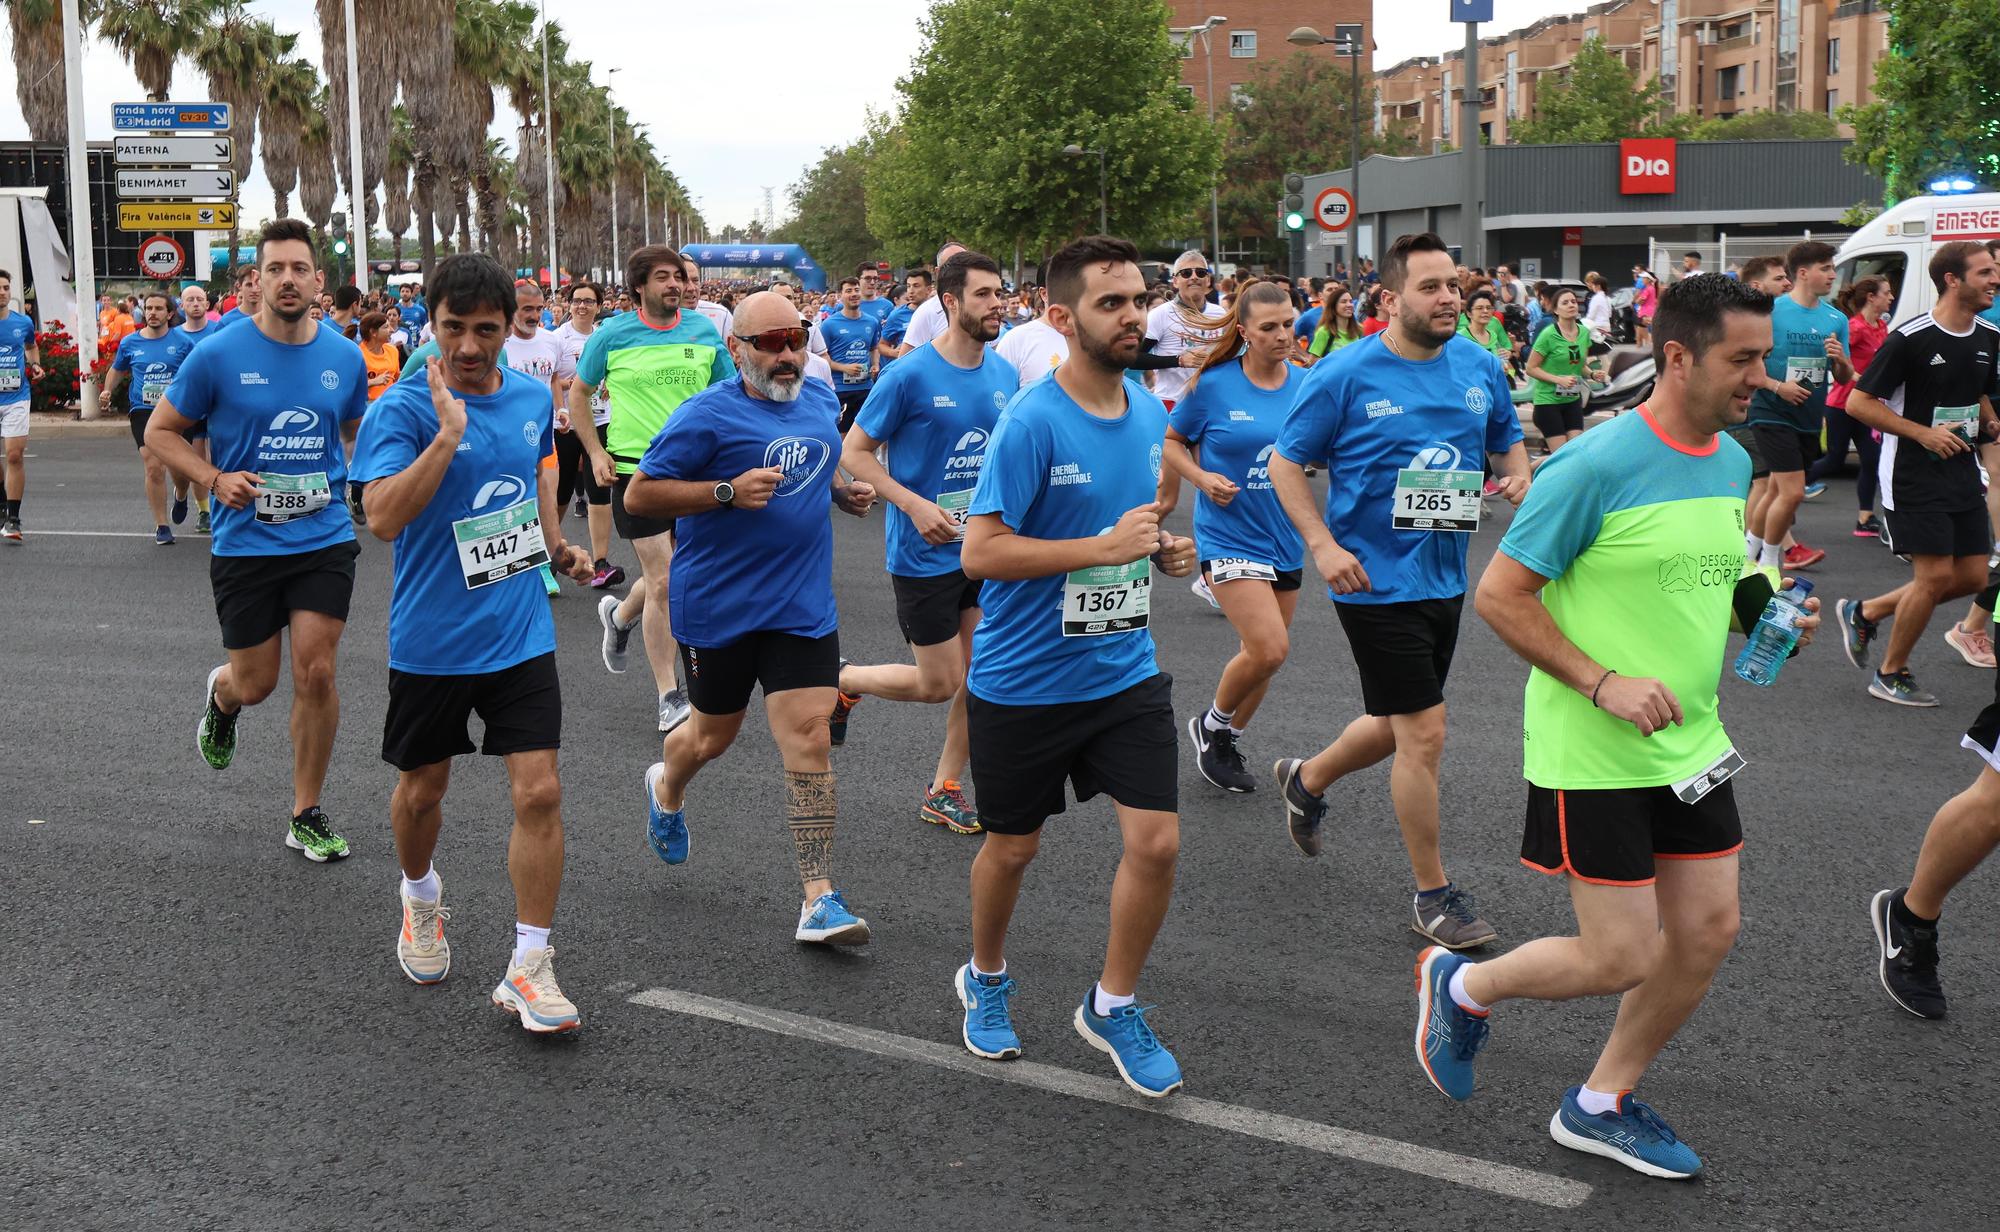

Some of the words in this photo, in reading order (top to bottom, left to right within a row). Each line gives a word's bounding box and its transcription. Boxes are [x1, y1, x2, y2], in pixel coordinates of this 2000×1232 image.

[115, 106, 145, 115] ronda
[151, 106, 175, 115] nord
[135, 118, 171, 126] Madrid
[117, 146, 169, 154] PATERNA
[119, 178, 187, 188] BENIMÀMET
[121, 212, 140, 221] Fira
[147, 212, 191, 221] València
[655, 369, 697, 377] DESGUACE
[656, 376, 697, 385] CORTES
[258, 436, 325, 449] POWER
[780, 441, 808, 473] life
[944, 455, 985, 470] POWE
[1050, 462, 1080, 476] ENERGÍA
[1050, 472, 1092, 486] INAGOTABLE
[263, 493, 307, 509] 1388
[1404, 493, 1452, 511] 1265
[470, 534, 518, 564] 1447
[1700, 554, 1748, 567] DESGUAC
[1136, 578, 1145, 588] 5K
[1076, 590, 1128, 612] 1367
